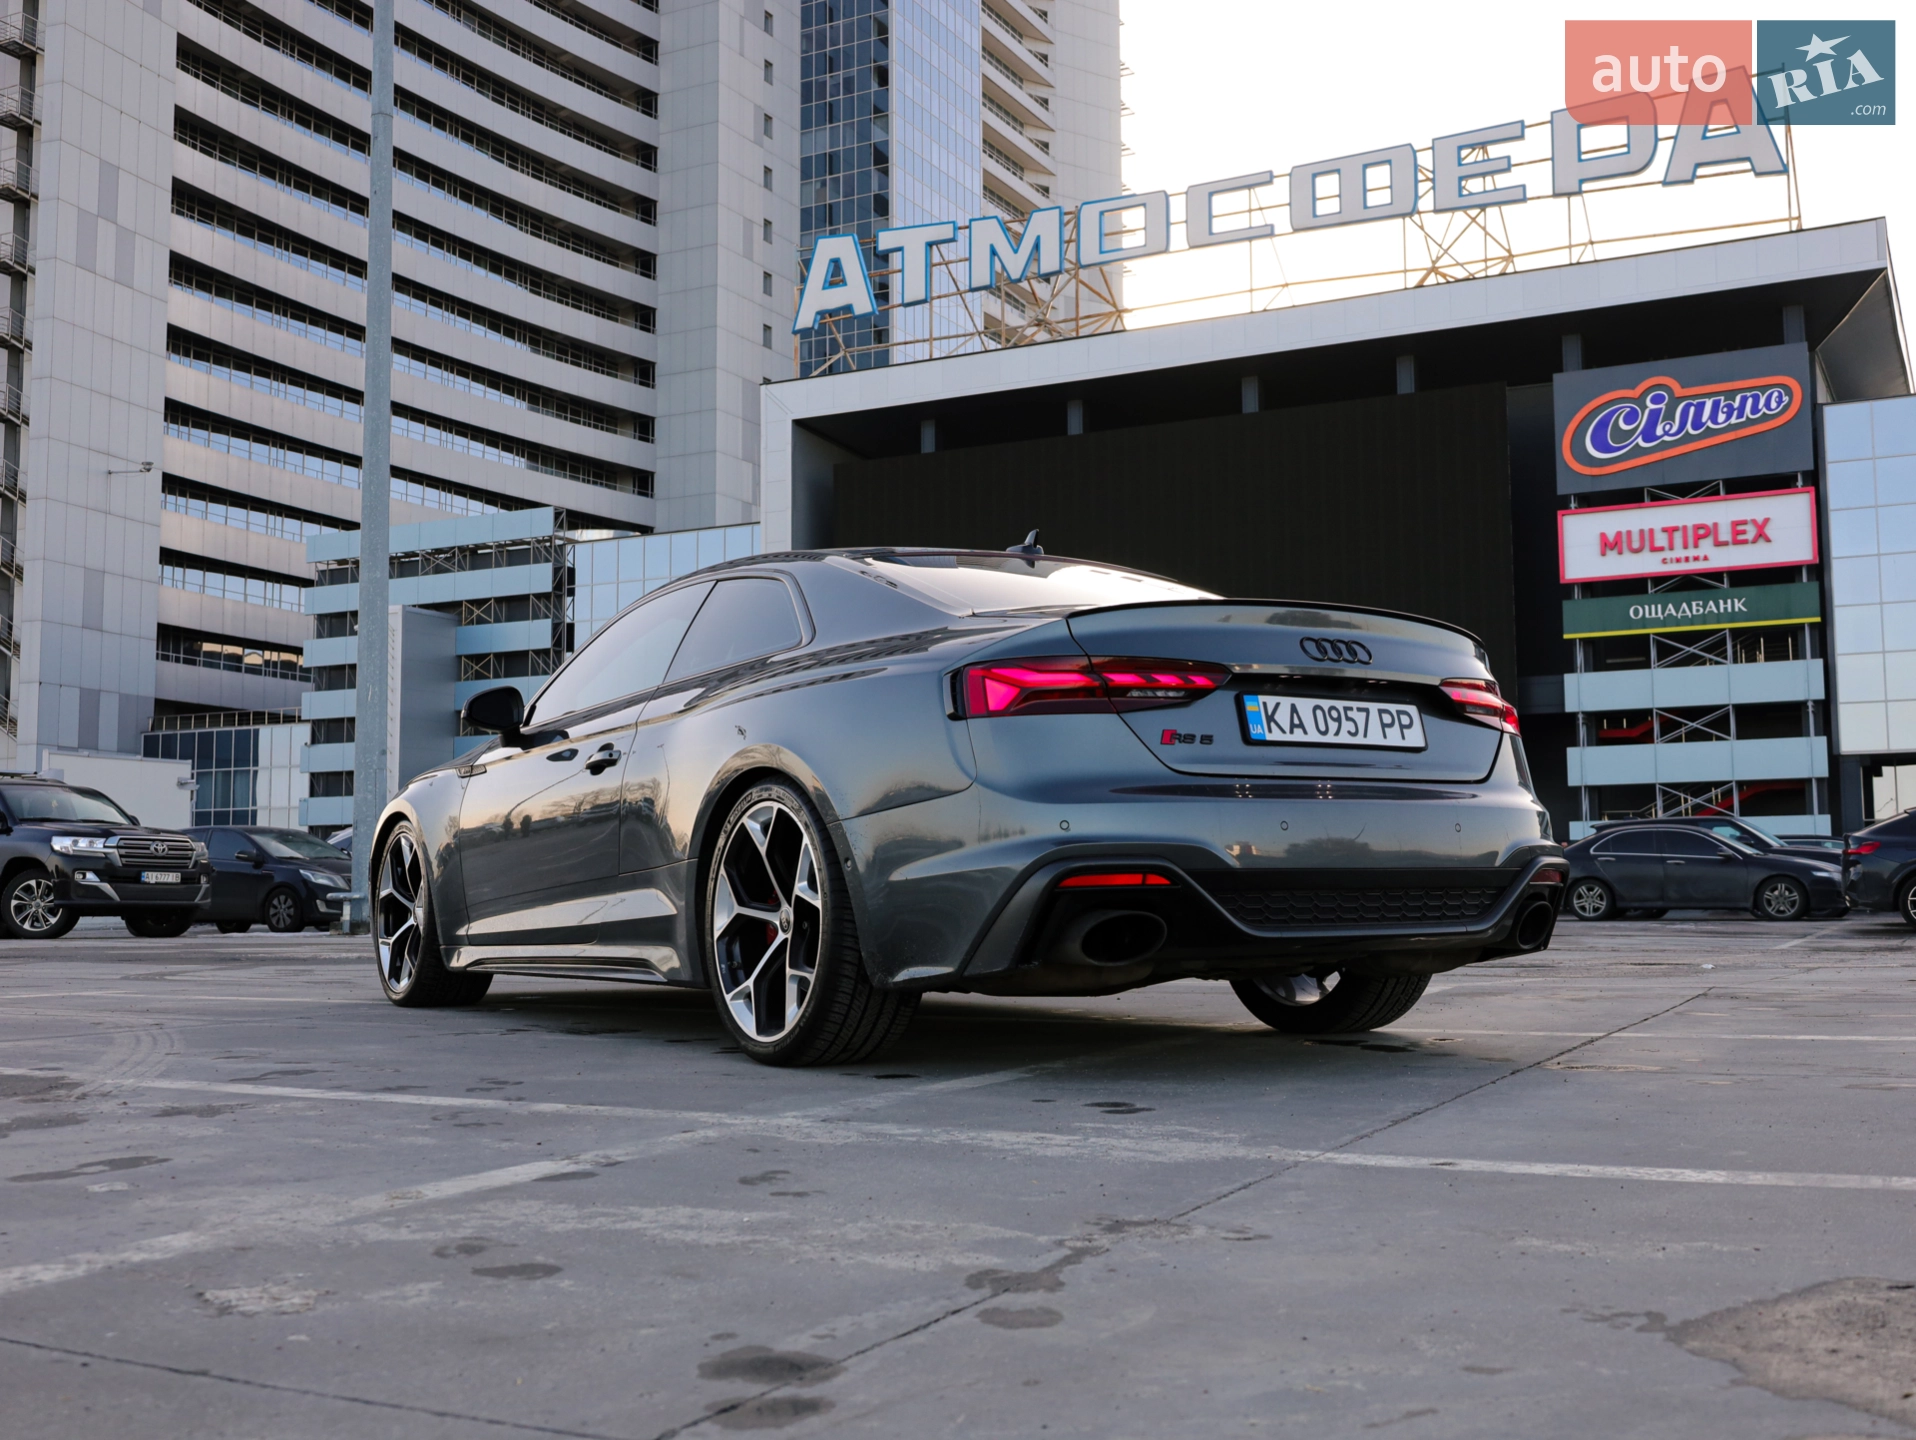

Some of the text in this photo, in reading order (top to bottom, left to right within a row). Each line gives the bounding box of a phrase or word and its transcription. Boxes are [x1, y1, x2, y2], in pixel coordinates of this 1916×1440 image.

[791, 65, 1789, 335] АТМОСФЕРА
[1585, 388, 1788, 459] Сільпо
[1599, 517, 1772, 556] MULTIPLEX
[1661, 554, 1709, 565] CINEMA
[1629, 597, 1747, 620] ОЩАДБАНК
[1250, 724, 1263, 735] UA
[1262, 701, 1414, 741] KA 0957 PP
[1200, 734, 1214, 746] 5
